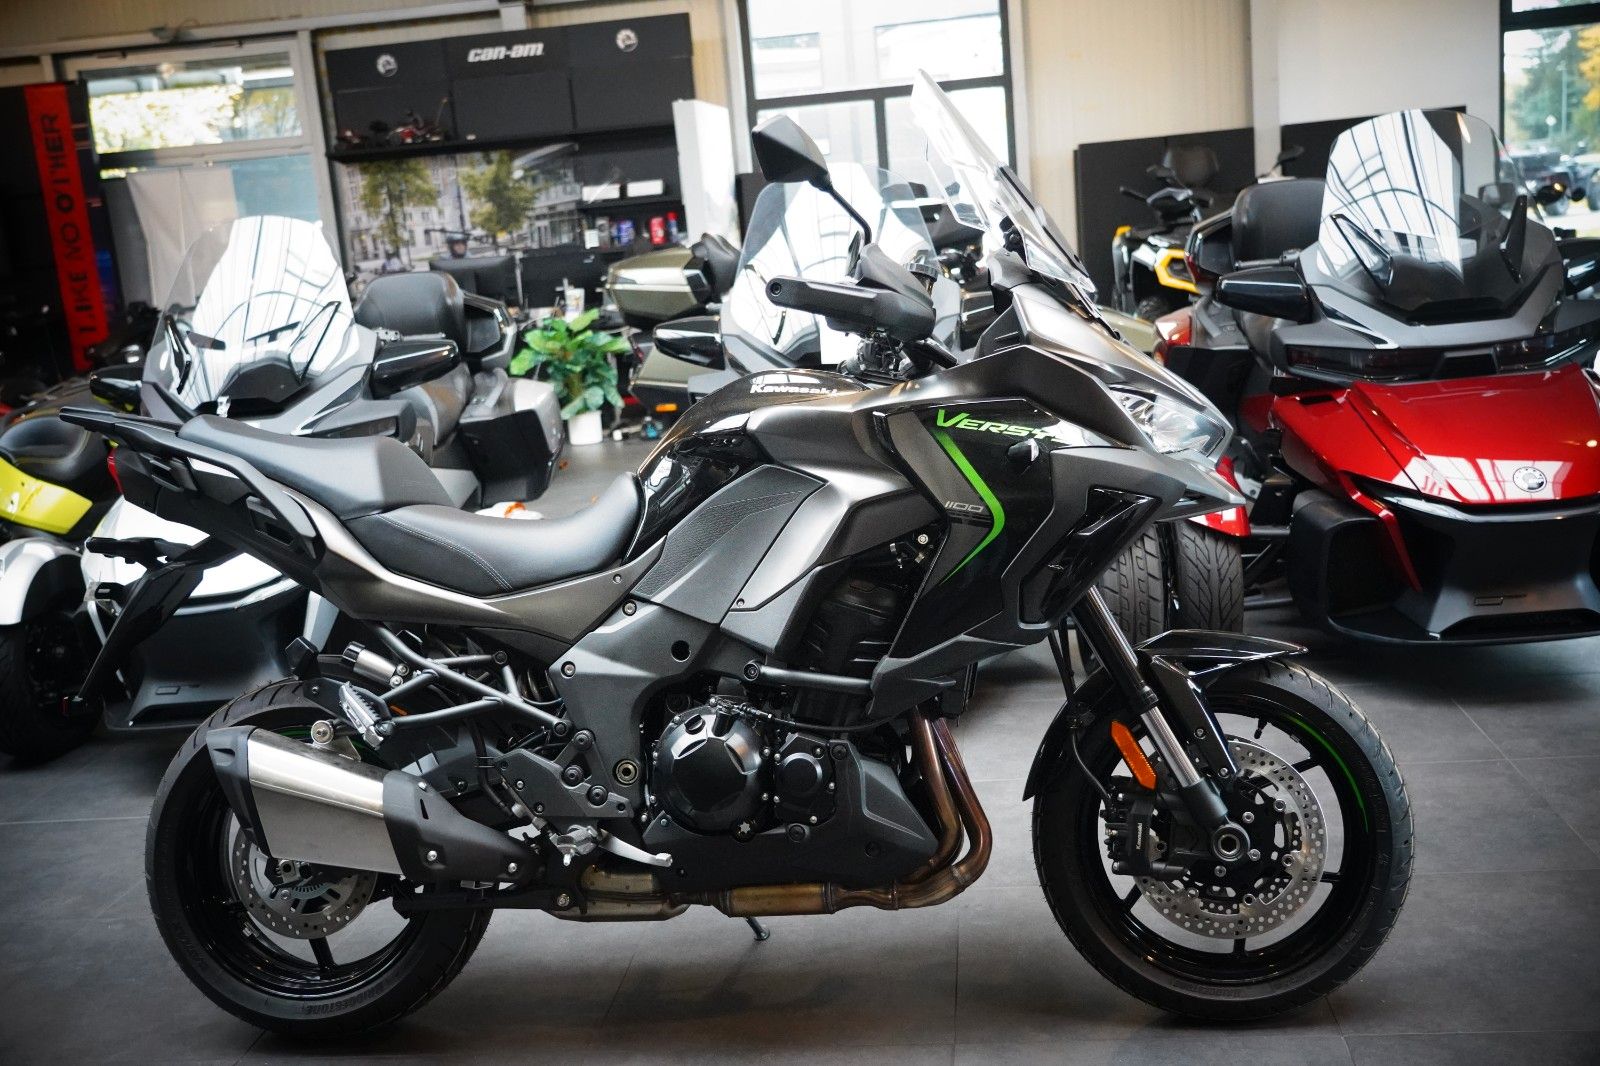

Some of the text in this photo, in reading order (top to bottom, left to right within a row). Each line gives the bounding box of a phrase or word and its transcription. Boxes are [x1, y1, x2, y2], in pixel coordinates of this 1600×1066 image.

[467, 42, 544, 63] can-am
[40, 114, 97, 333] LIKE NO OTHER
[750, 384, 838, 397] Kawasaki
[945, 500, 984, 513] 1100
